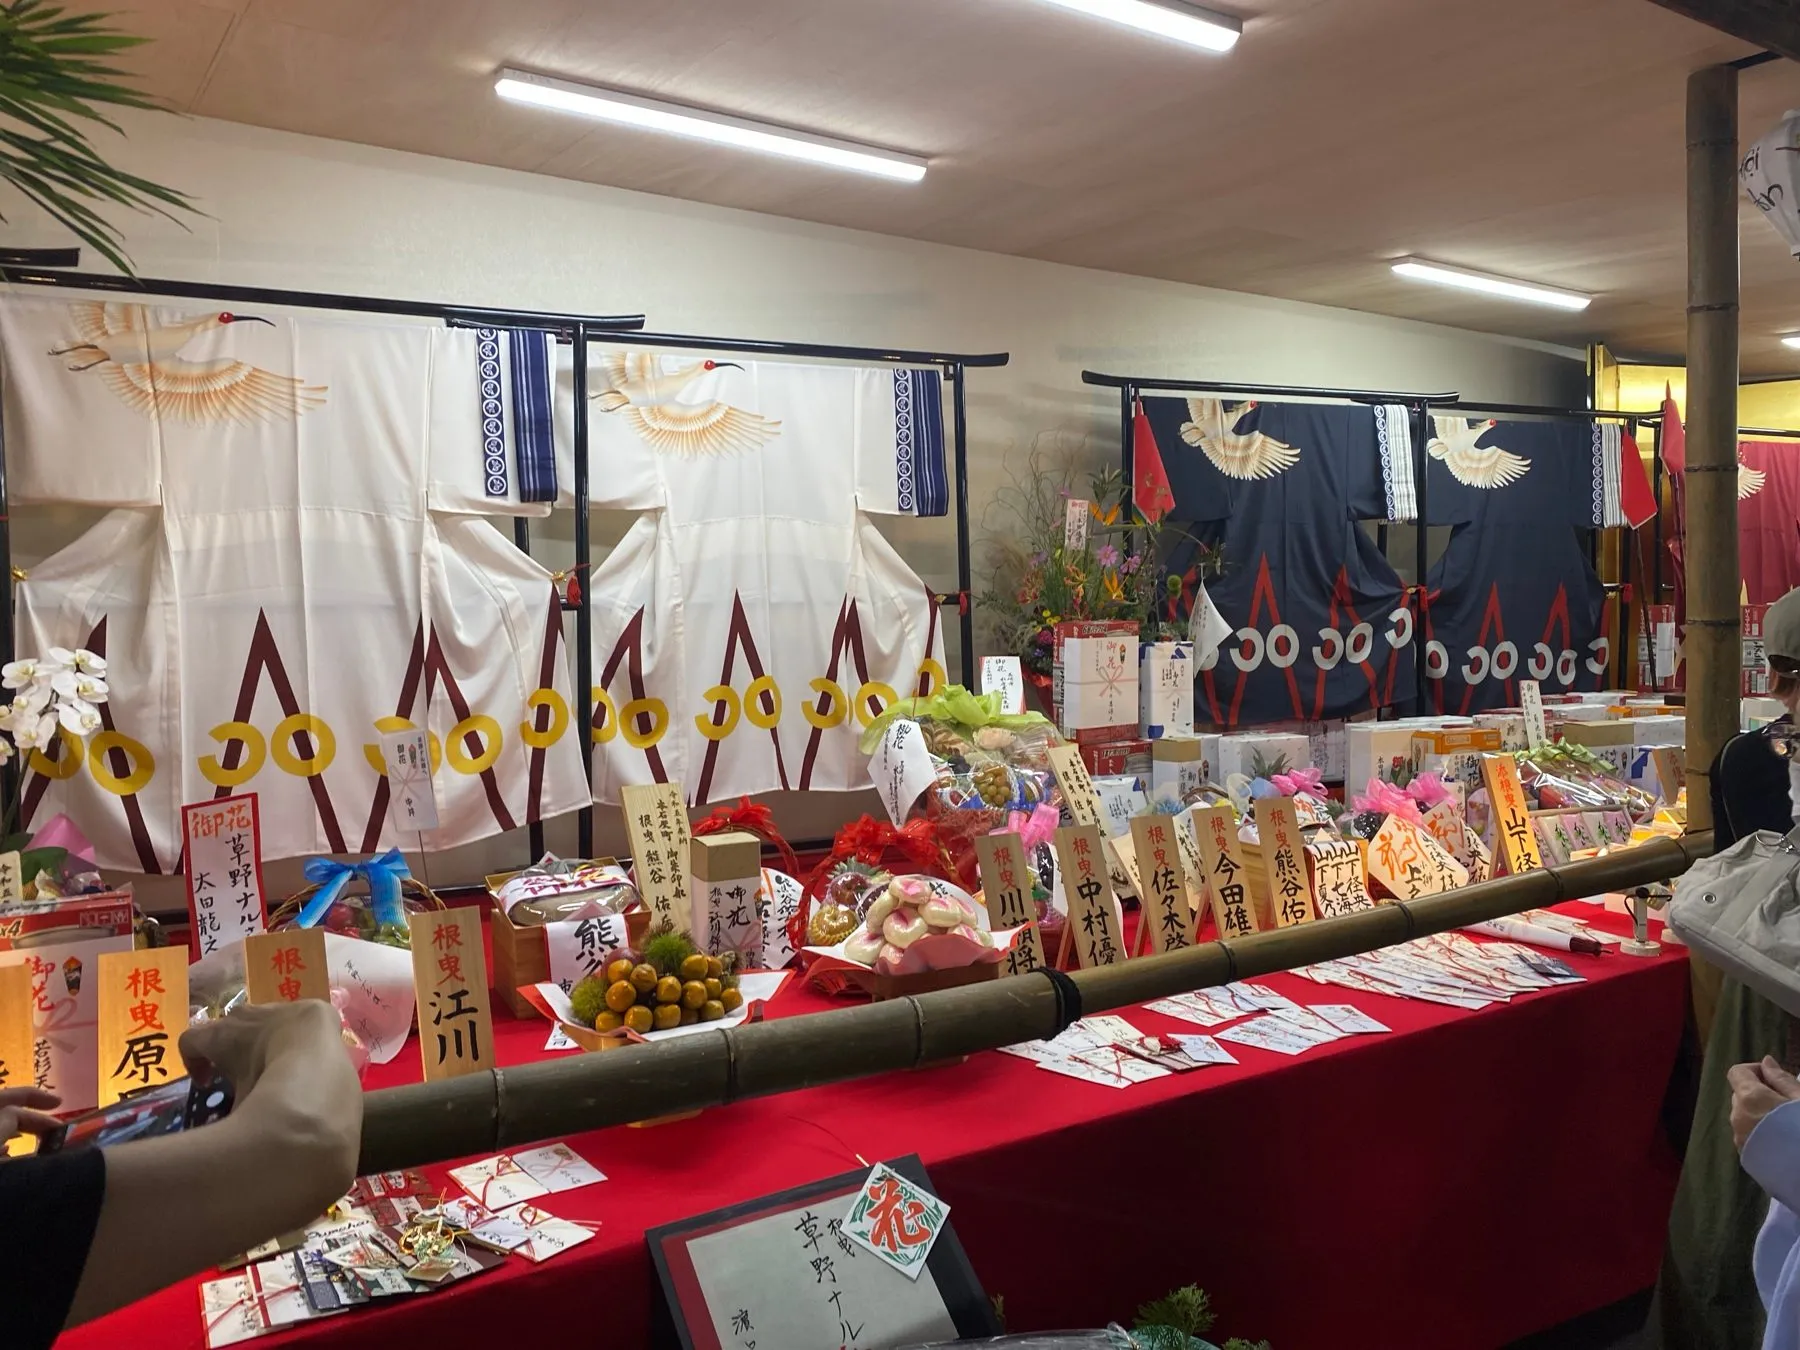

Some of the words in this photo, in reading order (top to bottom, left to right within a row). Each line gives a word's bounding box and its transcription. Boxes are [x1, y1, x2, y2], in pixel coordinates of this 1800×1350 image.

[192, 804, 252, 839] 御花
[1147, 825, 1170, 871] 根曳
[1210, 815, 1231, 854] 根曳
[1270, 808, 1291, 849] 根曳
[1505, 807, 1538, 873] 山下径
[645, 850, 667, 885] 熊谷
[993, 847, 1017, 891] 根曳
[1072, 838, 1096, 880] 根曳
[1275, 848, 1307, 926] 熊谷佑
[1313, 843, 1337, 918] 山下夏乃
[1326, 842, 1352, 915] 山下七海
[1340, 840, 1371, 912] 山下径央
[726, 884, 751, 930] 御花
[1077, 877, 1117, 967] 中村優
[1214, 852, 1253, 939] 今田雄
[271, 947, 307, 999] 根曳
[432, 923, 466, 987] 根曳
[125, 968, 166, 1035] 根曳
[429, 988, 480, 1066] 江川
[867, 1177, 933, 1254] 花
[794, 1210, 865, 1344] 草野ナル
